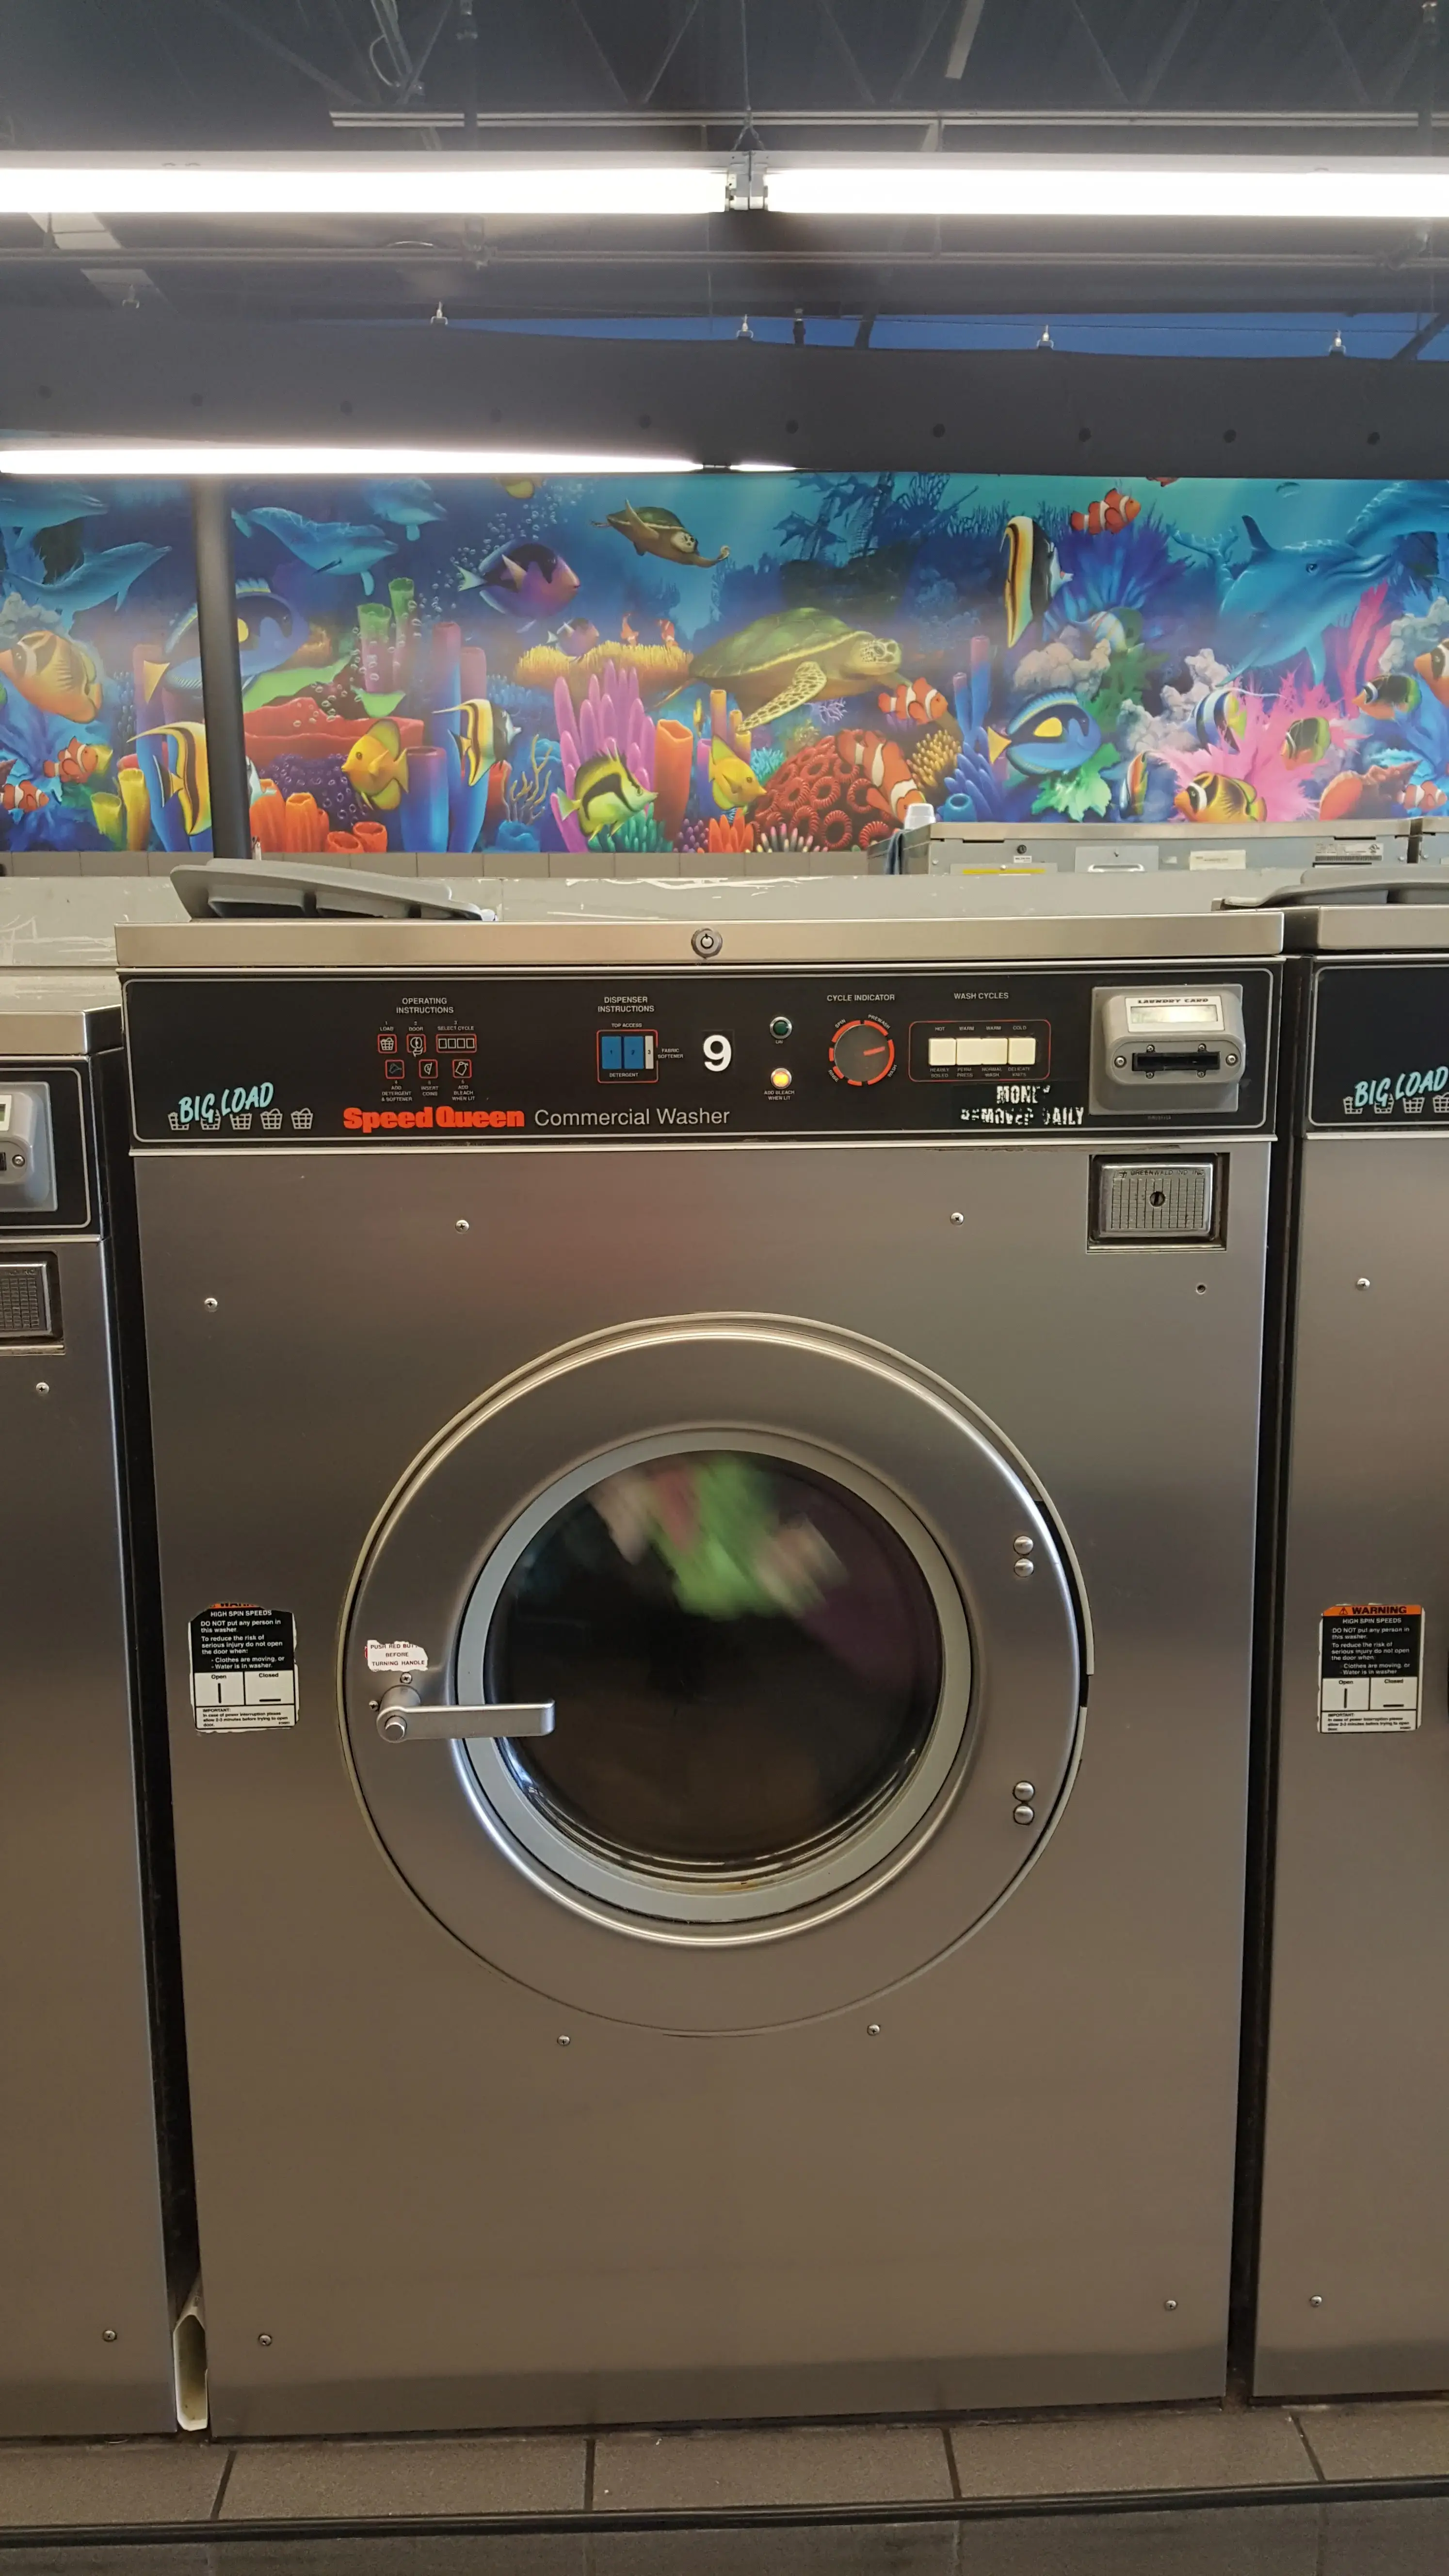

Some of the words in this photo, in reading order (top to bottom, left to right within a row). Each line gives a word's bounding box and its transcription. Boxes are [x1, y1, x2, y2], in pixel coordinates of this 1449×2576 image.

[835, 1018, 846, 1029] SPIN
[868, 1014, 891, 1030] PREWASH
[703, 1034, 731, 1072] 9
[828, 1069, 839, 1082] RINSE
[887, 1064, 898, 1078] WASH
[1354, 1078, 1391, 1107] BIG
[1395, 1066, 1449, 1100] LOAD
[178, 1093, 215, 1123] BIG
[221, 1082, 274, 1116] LOAD
[343, 1106, 433, 1133] Speed
[436, 1106, 525, 1128] Queen
[535, 1108, 649, 1127] Commercial
[656, 1108, 730, 1125] Washer
[1352, 1606, 1407, 1614] WARNING
